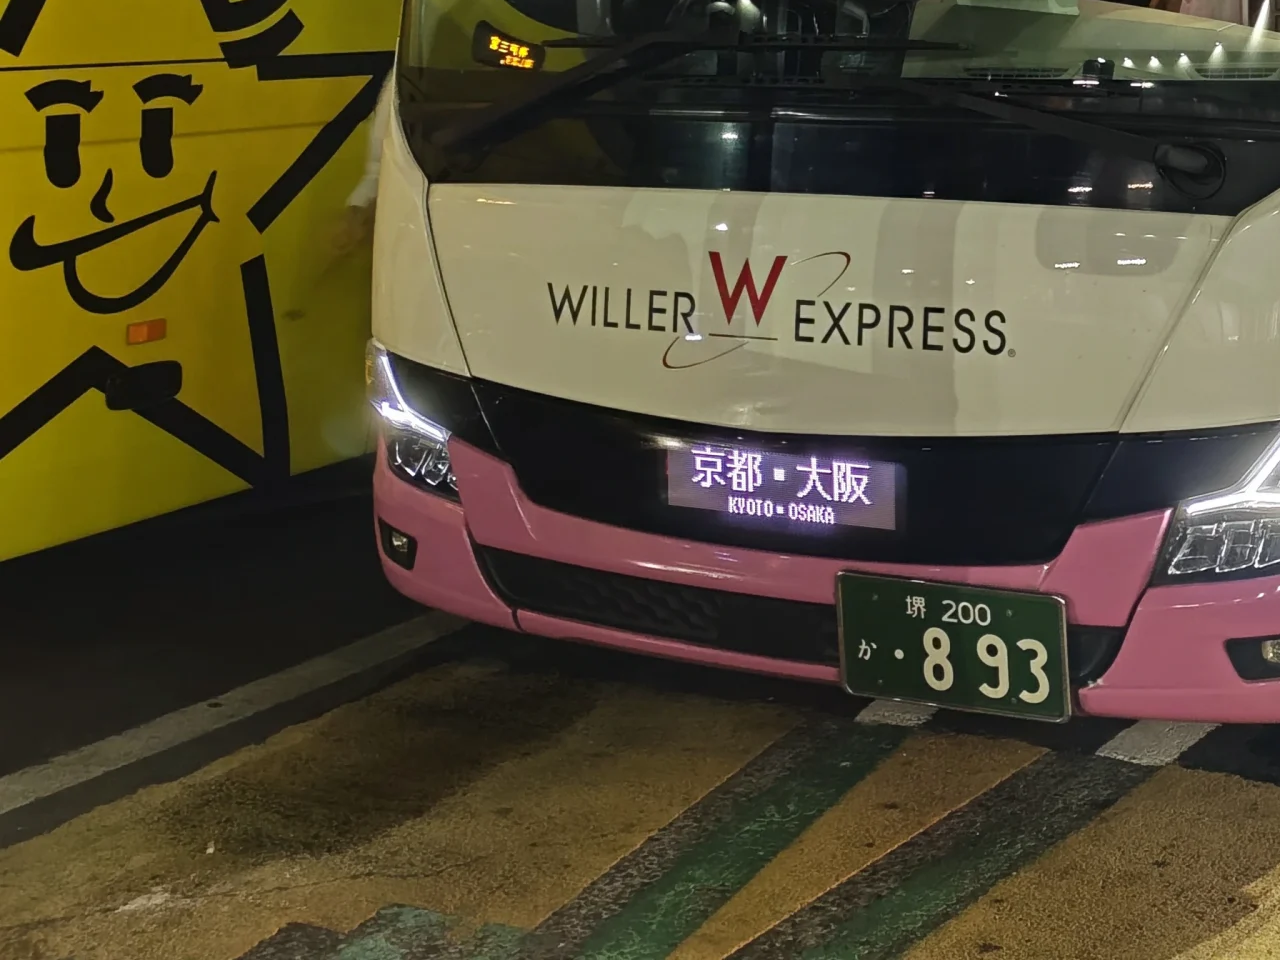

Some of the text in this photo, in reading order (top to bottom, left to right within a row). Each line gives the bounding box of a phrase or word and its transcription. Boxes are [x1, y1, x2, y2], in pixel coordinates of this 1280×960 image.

[547, 251, 1007, 356] WILLER W EXPRESS
[905, 595, 991, 626] 堺 200
[858, 639, 877, 661] か
